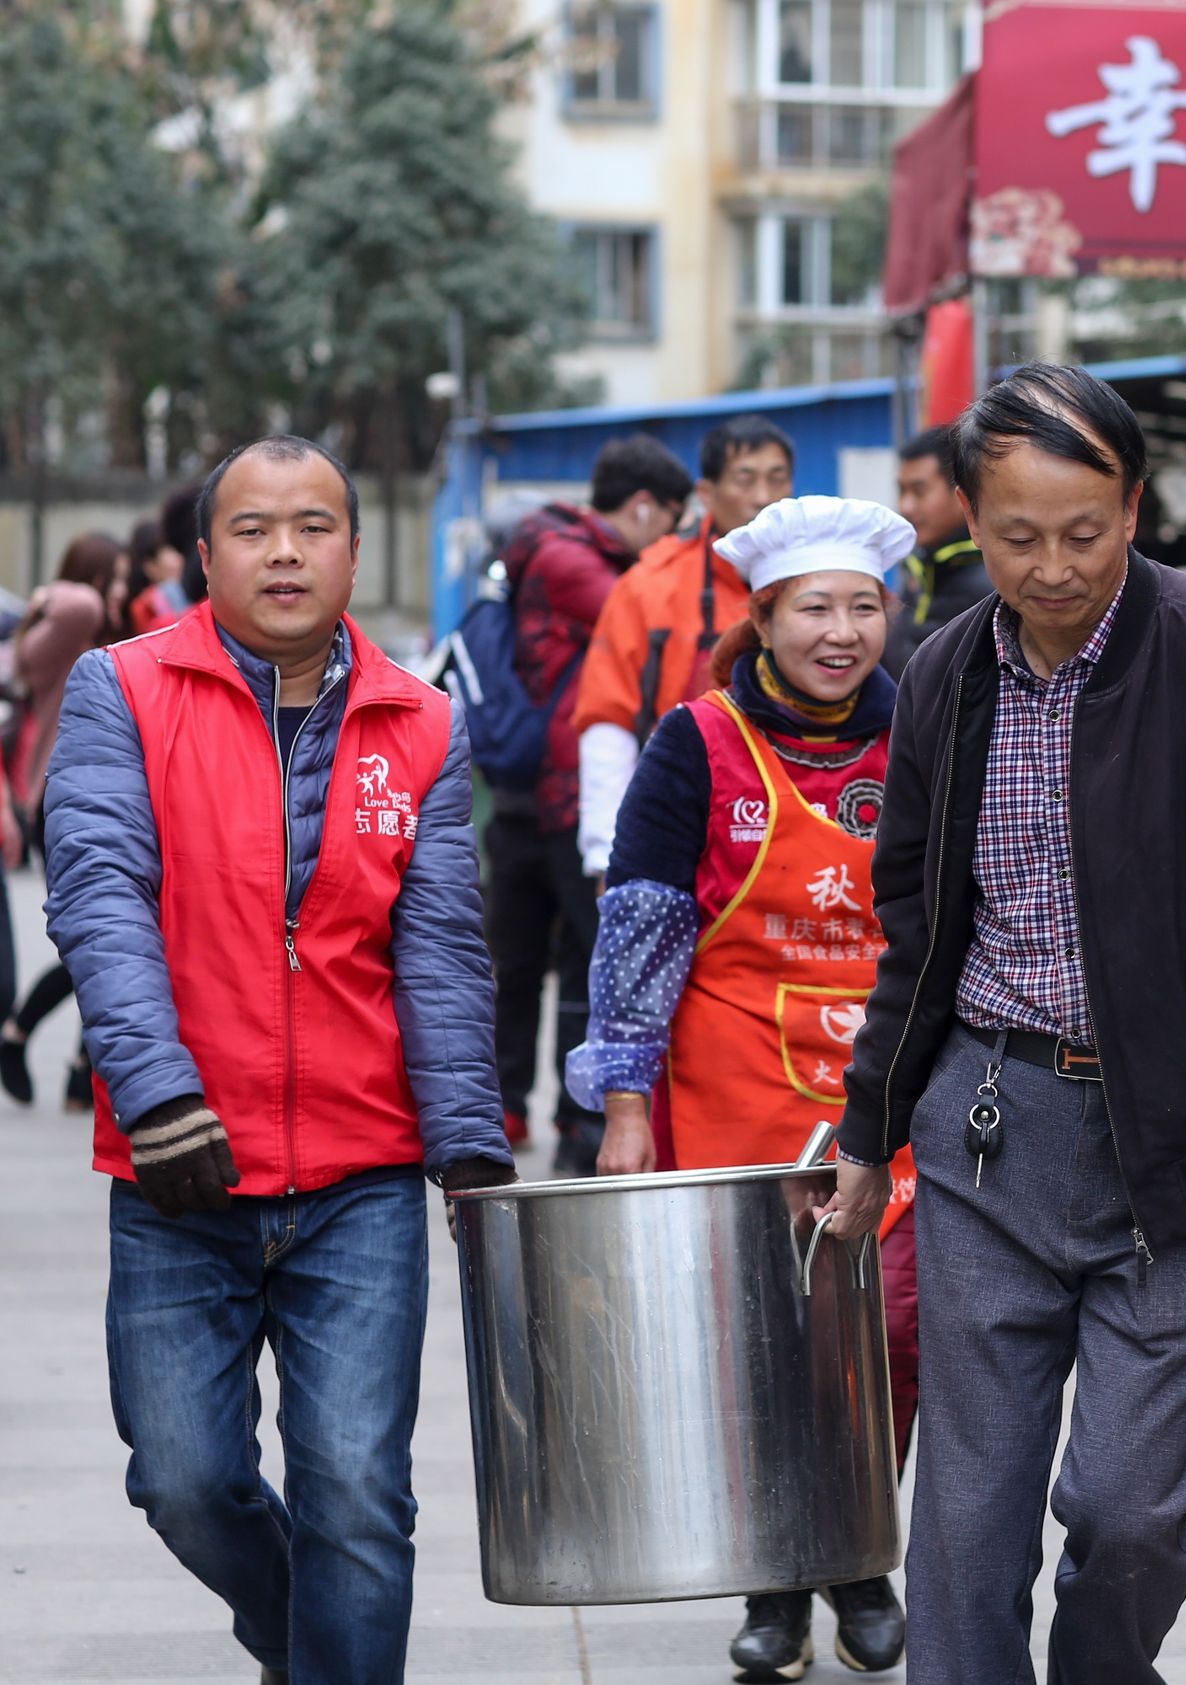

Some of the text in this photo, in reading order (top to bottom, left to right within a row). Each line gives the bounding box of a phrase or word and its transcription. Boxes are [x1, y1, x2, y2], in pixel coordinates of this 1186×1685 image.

[364, 796, 412, 813] Love Bds
[355, 807, 419, 840] 志愿者
[805, 863, 863, 912] 秋
